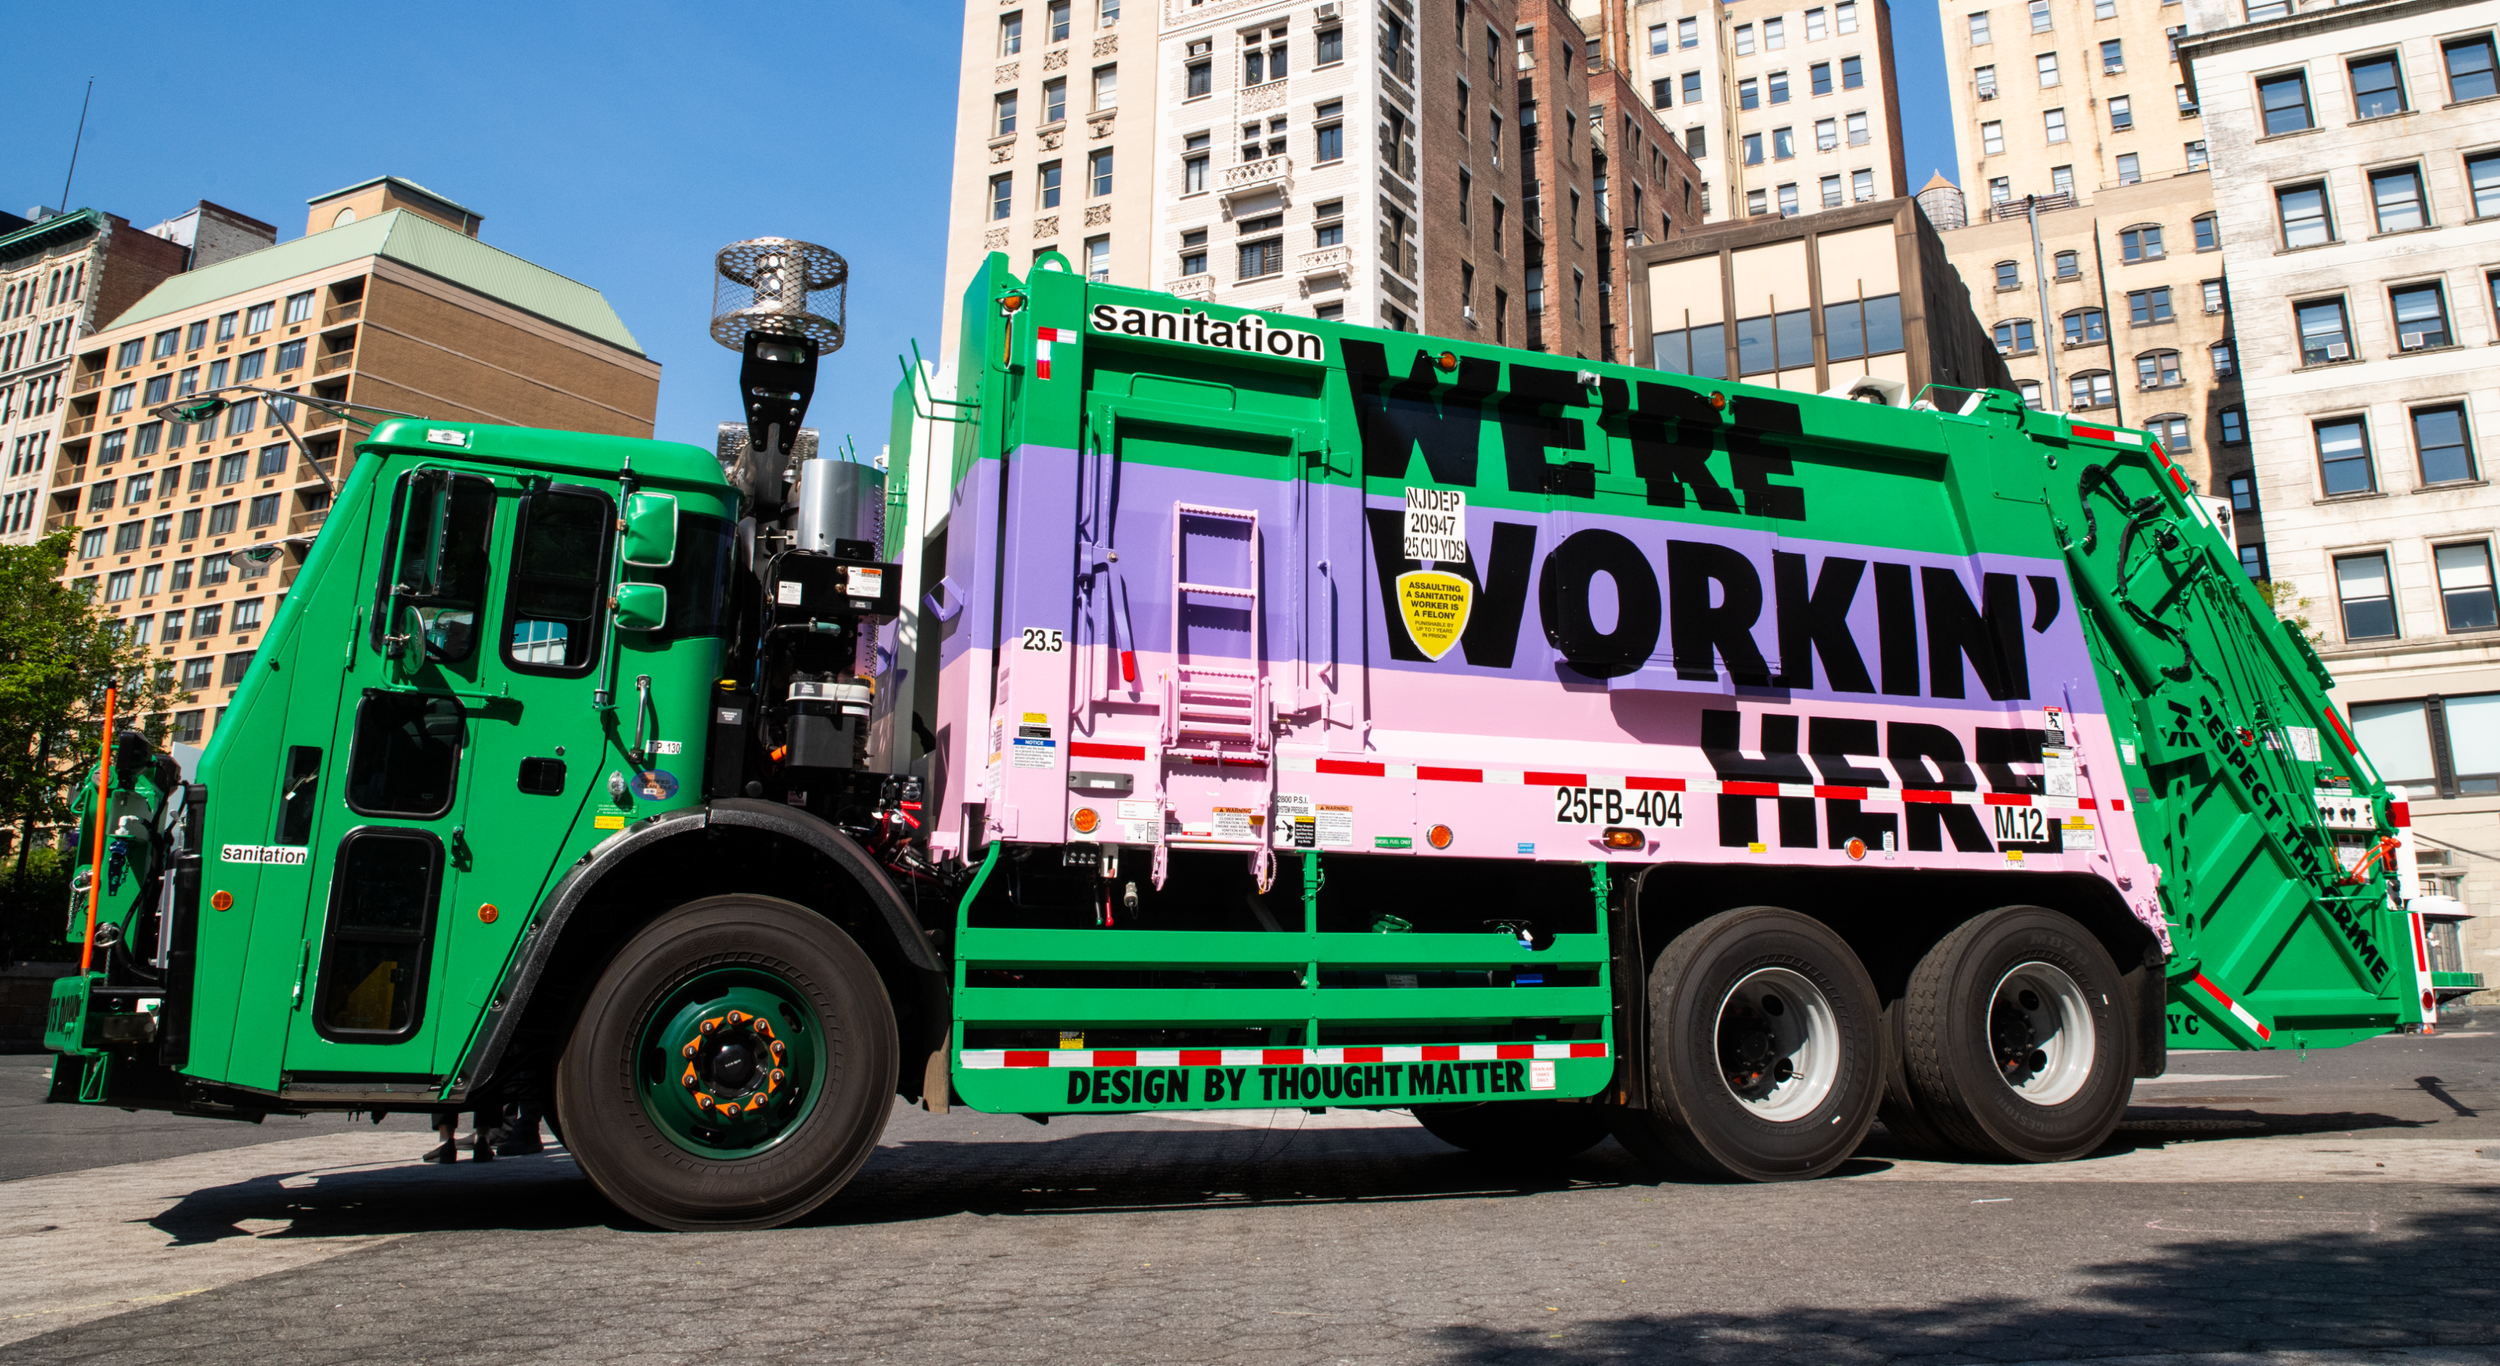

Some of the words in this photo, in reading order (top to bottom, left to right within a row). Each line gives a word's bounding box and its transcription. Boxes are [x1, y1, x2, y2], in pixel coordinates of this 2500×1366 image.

[1093, 307, 1321, 361] sanitation
[1340, 338, 1806, 521] WE'RE
[1407, 488, 1460, 512] NJDEP
[1411, 513, 1456, 536] 20947
[1405, 536, 1419, 557] 25
[1420, 538, 1438, 559] CU
[1440, 539, 1464, 561] YDS
[1409, 581, 1461, 593] ASSAULTING
[1414, 591, 1464, 602] SANITATION
[1366, 508, 2060, 701] WORKIN'
[1411, 600, 1448, 611] WORKER
[1422, 610, 1456, 620] FELONY
[1415, 620, 1446, 628] PUNISHABLE
[1023, 629, 1062, 652] 23.5
[650, 742, 664, 753] T.P.
[667, 743, 681, 754] 130
[2200, 695, 2283, 822] RESPECT
[1702, 709, 2063, 853] HERE
[1277, 795, 1292, 803] 2800
[1294, 796, 1309, 804] P.S.I.
[1557, 786, 1682, 827] 25FB-404
[1994, 806, 2044, 840] M.12
[222, 846, 306, 864] sanitation
[2282, 822, 2322, 888] THE
[2322, 886, 2389, 984] GRIME
[2029, 934, 2090, 966] M870
[1067, 1069, 1189, 1104] DESIGN
[1204, 1068, 1247, 1102] BY
[1259, 1064, 1403, 1101] THOUGHT
[1408, 1060, 1525, 1096] MATTER
